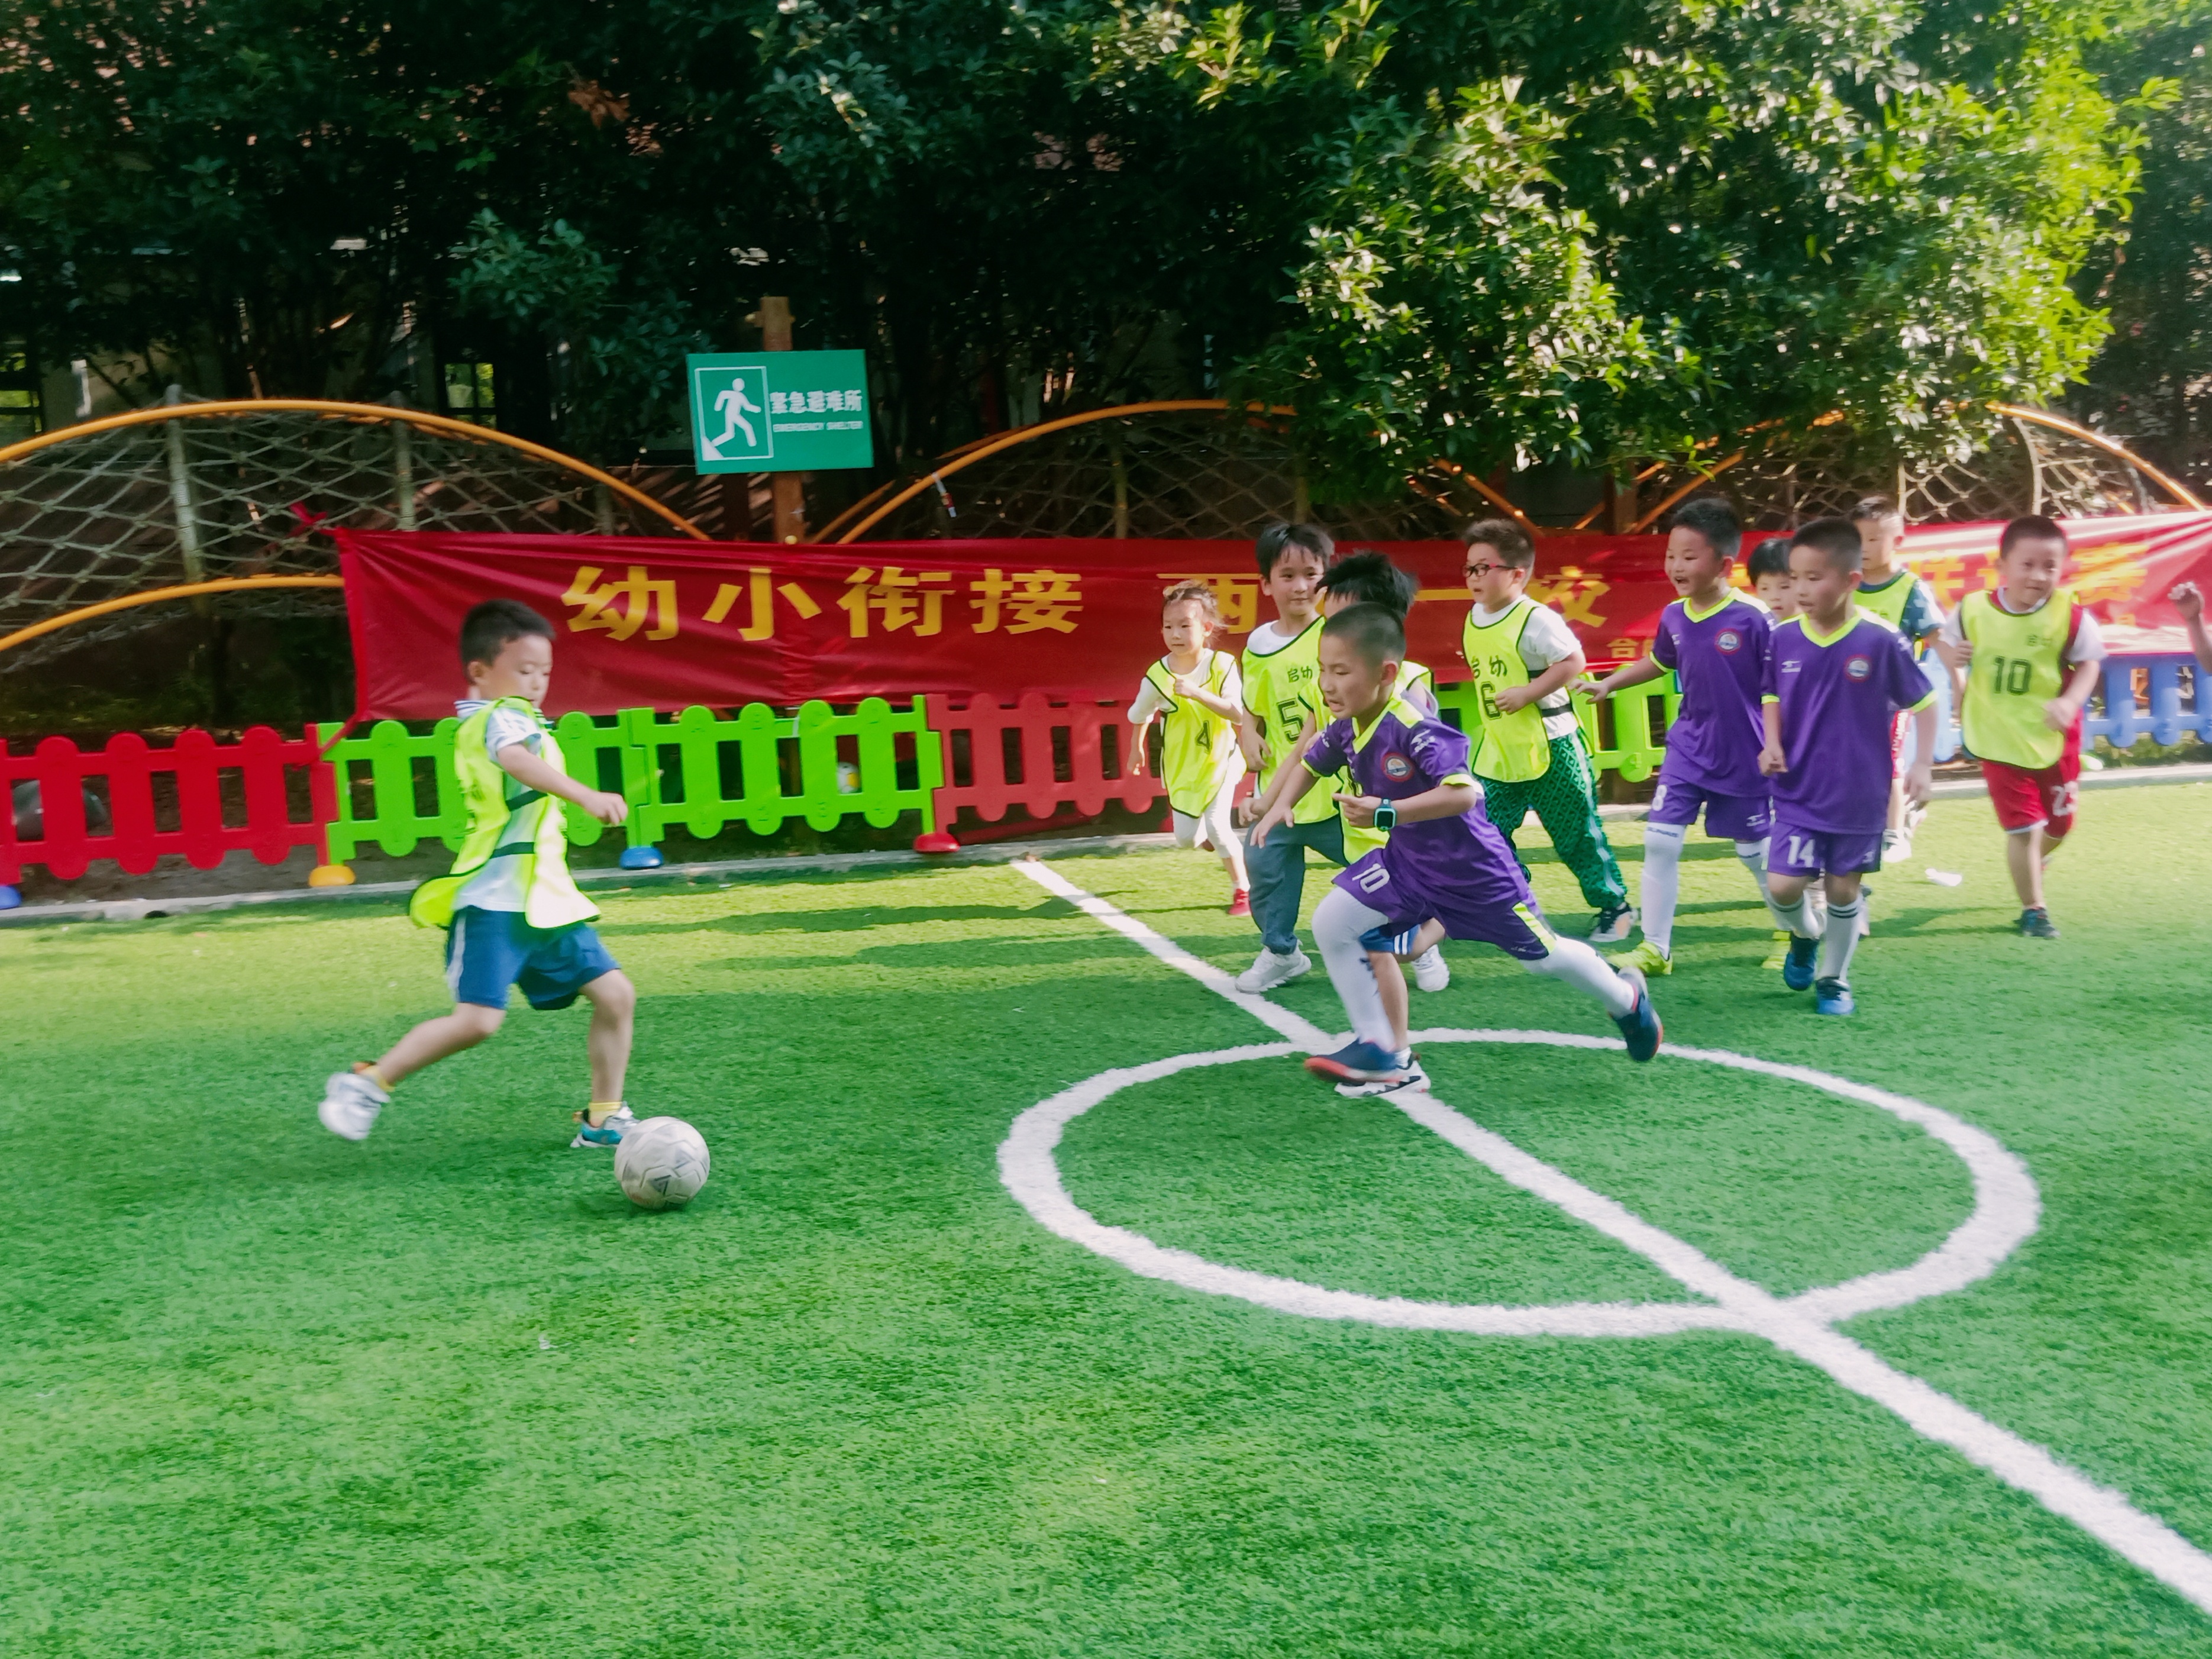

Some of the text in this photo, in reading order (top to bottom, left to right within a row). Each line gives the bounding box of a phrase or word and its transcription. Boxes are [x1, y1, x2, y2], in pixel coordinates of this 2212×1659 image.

[561, 566, 1084, 641] 幼小衔接
[1287, 665, 1313, 683] 启幼
[1992, 655, 2032, 696] 10
[1480, 681, 1502, 720] 6
[1194, 719, 1213, 755] 4
[1276, 698, 1304, 744] 5
[1787, 835, 1816, 868] 14
[1351, 863, 1390, 894] 10
